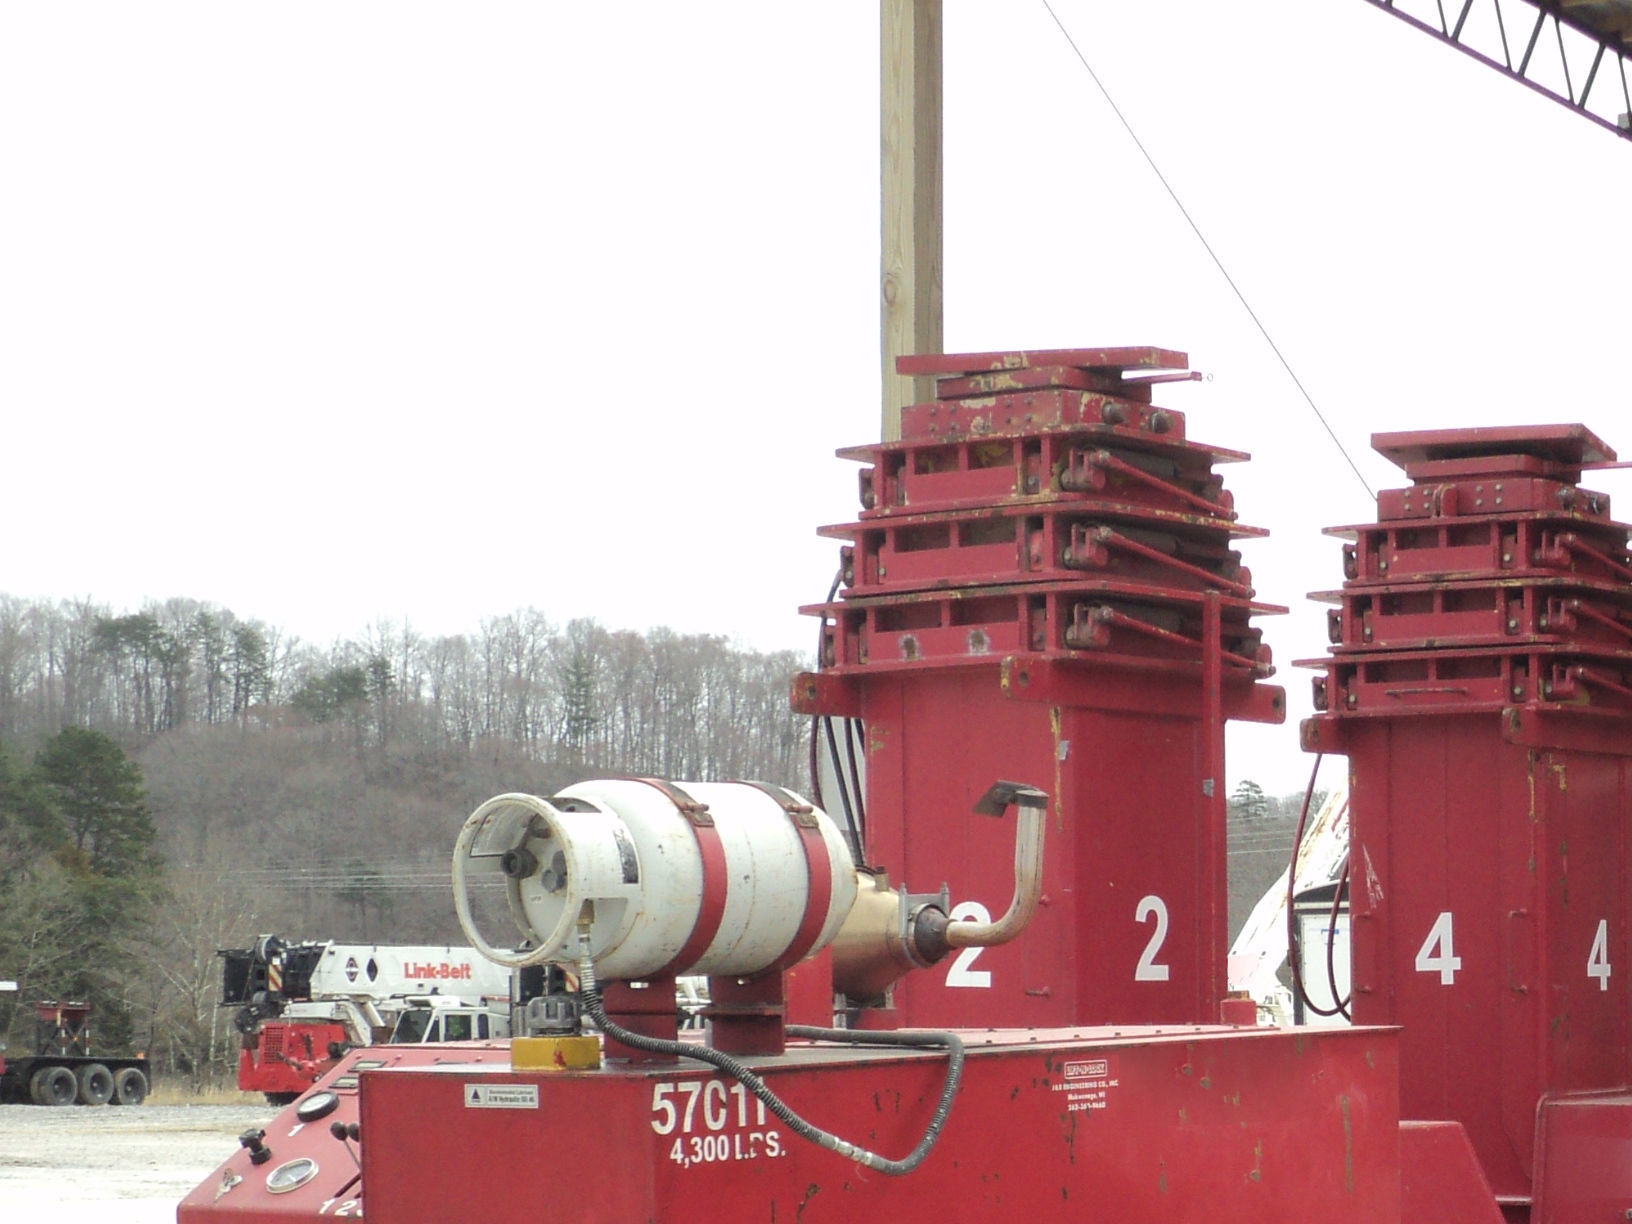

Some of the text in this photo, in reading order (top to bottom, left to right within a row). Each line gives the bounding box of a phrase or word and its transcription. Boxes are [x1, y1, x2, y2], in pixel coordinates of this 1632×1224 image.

[404, 962, 471, 979] Link-Belt
[945, 901, 991, 988] 2
[1135, 895, 1169, 981] 2
[1415, 912, 1461, 985] 4
[1587, 919, 1611, 991] 4
[670, 1134, 730, 1169] 4,300
[318, 1199, 336, 1214] 1
[334, 1200, 358, 1216] 2
